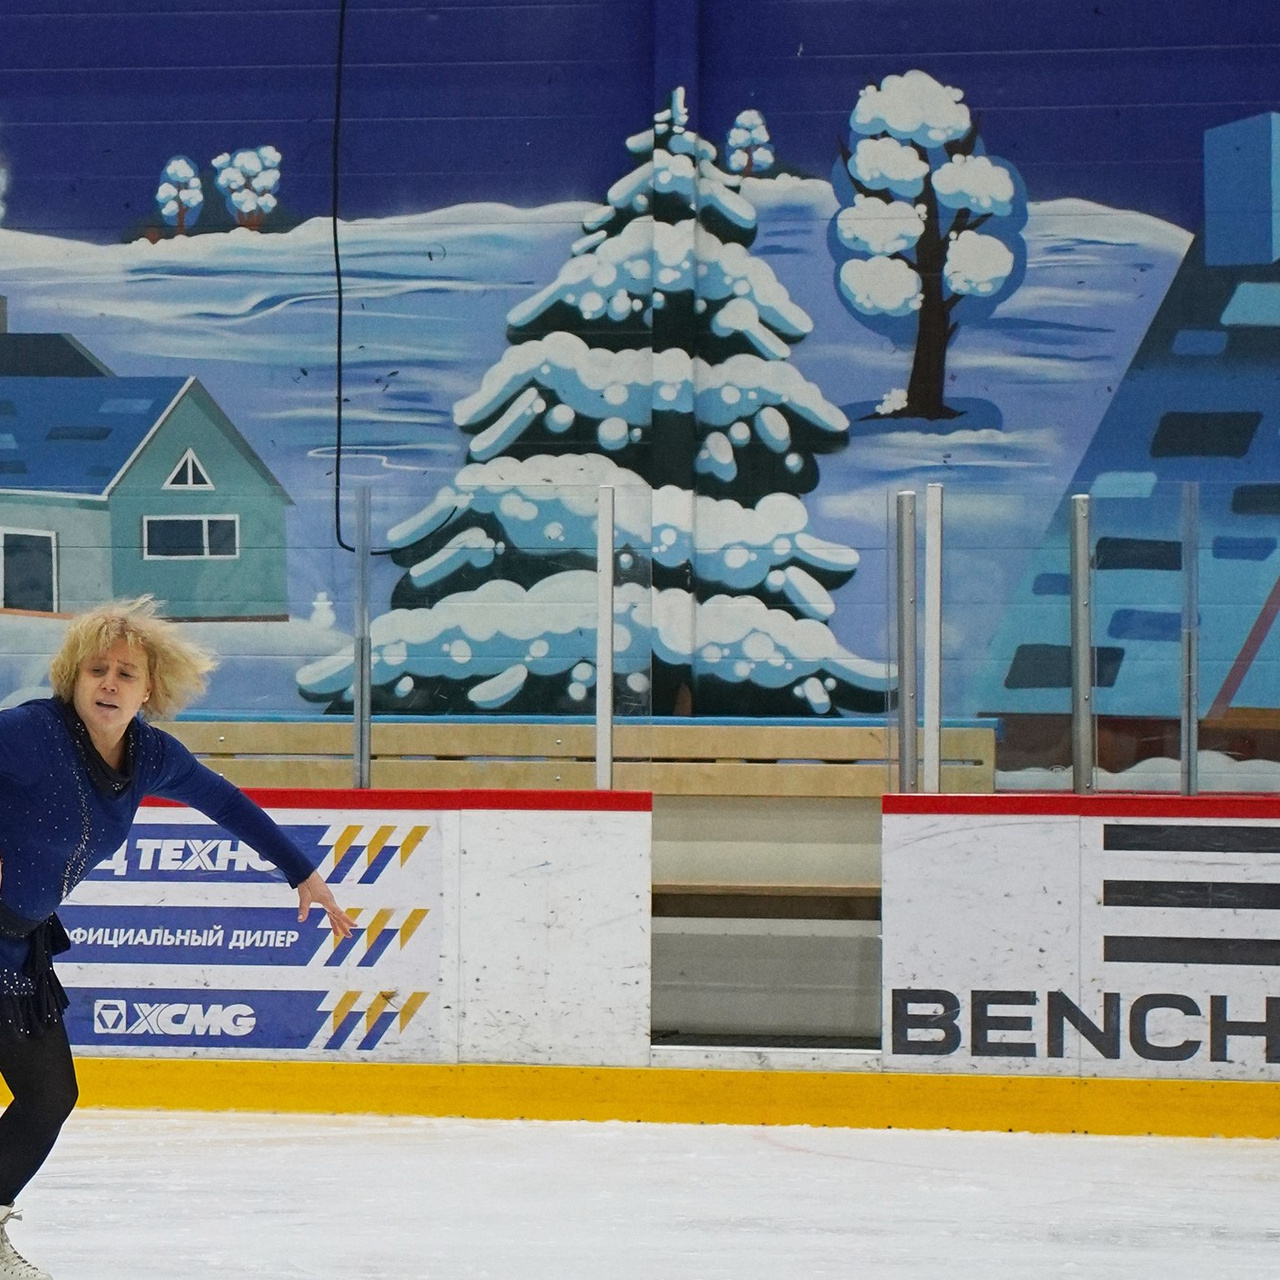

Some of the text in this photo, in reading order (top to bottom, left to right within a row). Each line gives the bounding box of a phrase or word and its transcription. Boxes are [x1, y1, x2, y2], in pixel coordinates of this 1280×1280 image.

[66, 925, 299, 950] ФИЦИАЛЬНЫЙ ДИЛЕР
[126, 1003, 257, 1036] XCMG
[891, 988, 1280, 1064] BENCH
